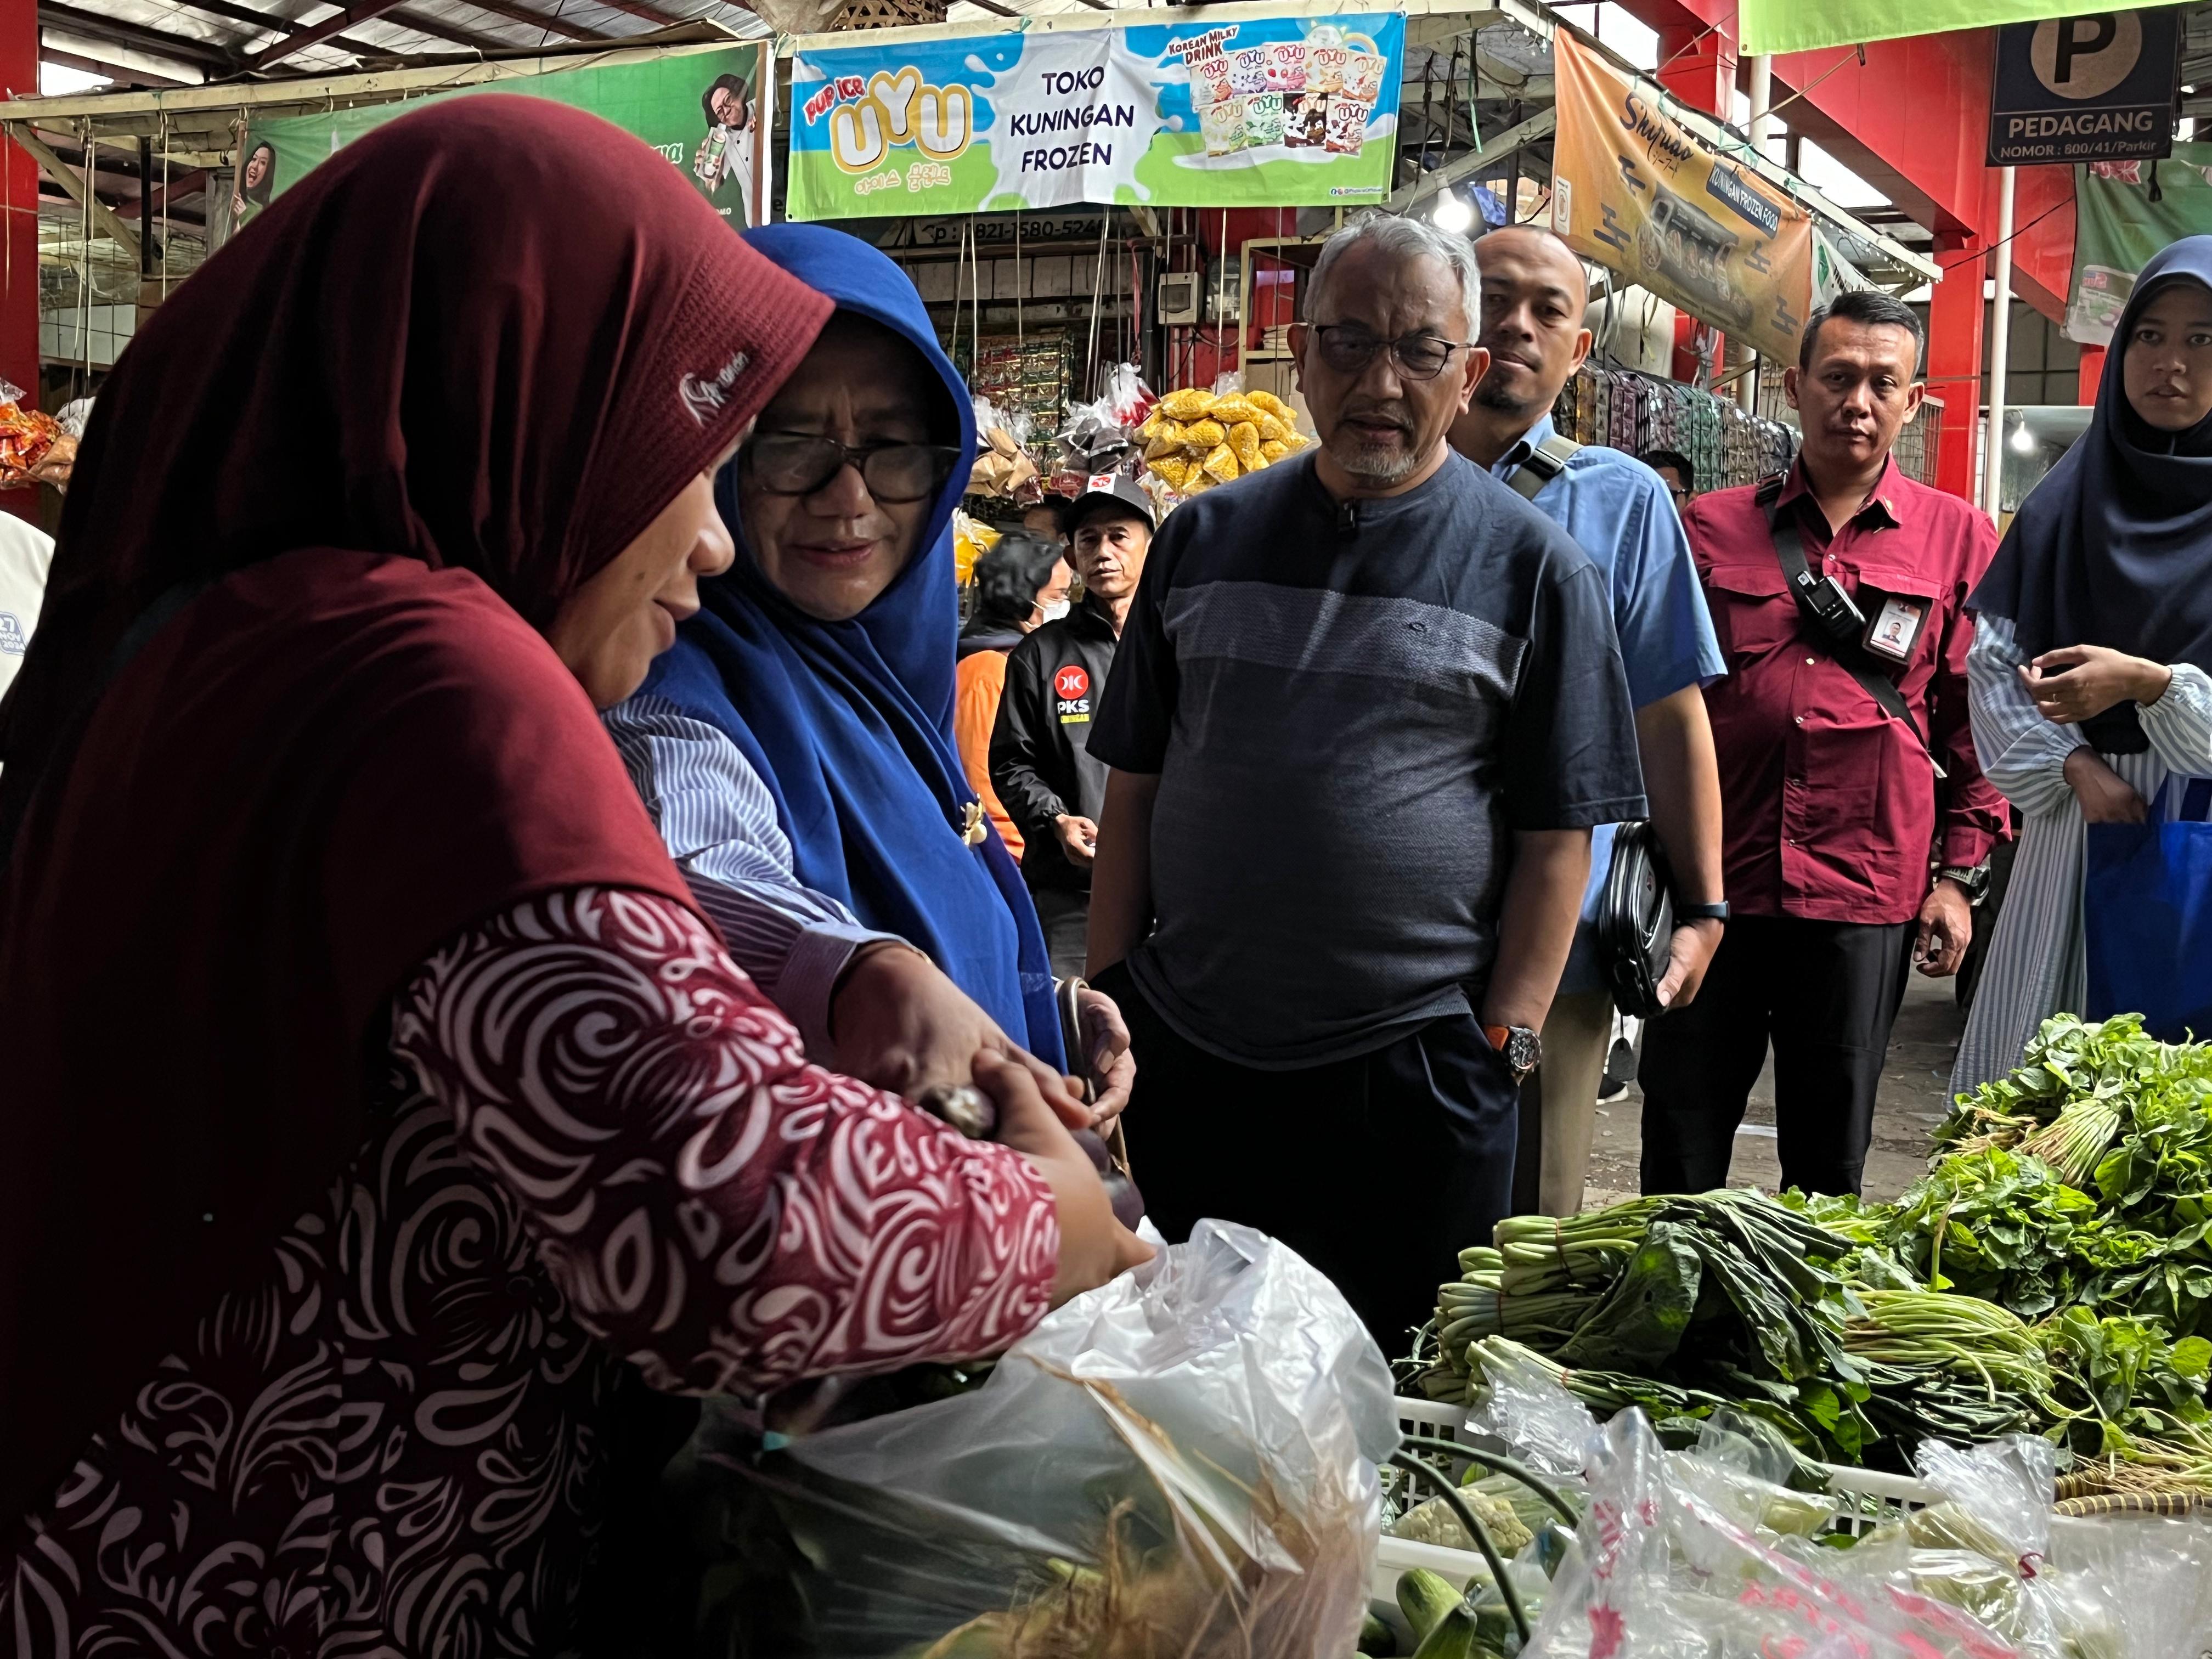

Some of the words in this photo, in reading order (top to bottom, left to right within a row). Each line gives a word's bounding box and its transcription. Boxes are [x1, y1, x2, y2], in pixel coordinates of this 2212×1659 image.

[1169, 36, 1207, 54] KOREAN
[1209, 27, 1237, 43] MILKY
[2054, 15, 2116, 83] P
[1186, 42, 1222, 64] DRINK
[1240, 50, 1265, 68] UYU
[1279, 45, 1305, 63] UYU
[1319, 49, 1346, 65] UYU
[1042, 66, 1104, 95] TOKO
[1204, 60, 1228, 79] UYU
[1254, 95, 1282, 114] UYU
[1339, 104, 1368, 122] UYU
[831, 67, 970, 173] UYU
[1011, 104, 1134, 137] KUNINGAN
[2009, 111, 2153, 138] PEDAGANG
[1022, 142, 1111, 172] FROZEN
[2001, 144, 2054, 158] NOMOR
[1740, 190, 1764, 221] FROZEN
[1762, 207, 1778, 232] FOOD
[1057, 699, 1090, 714] PKS
